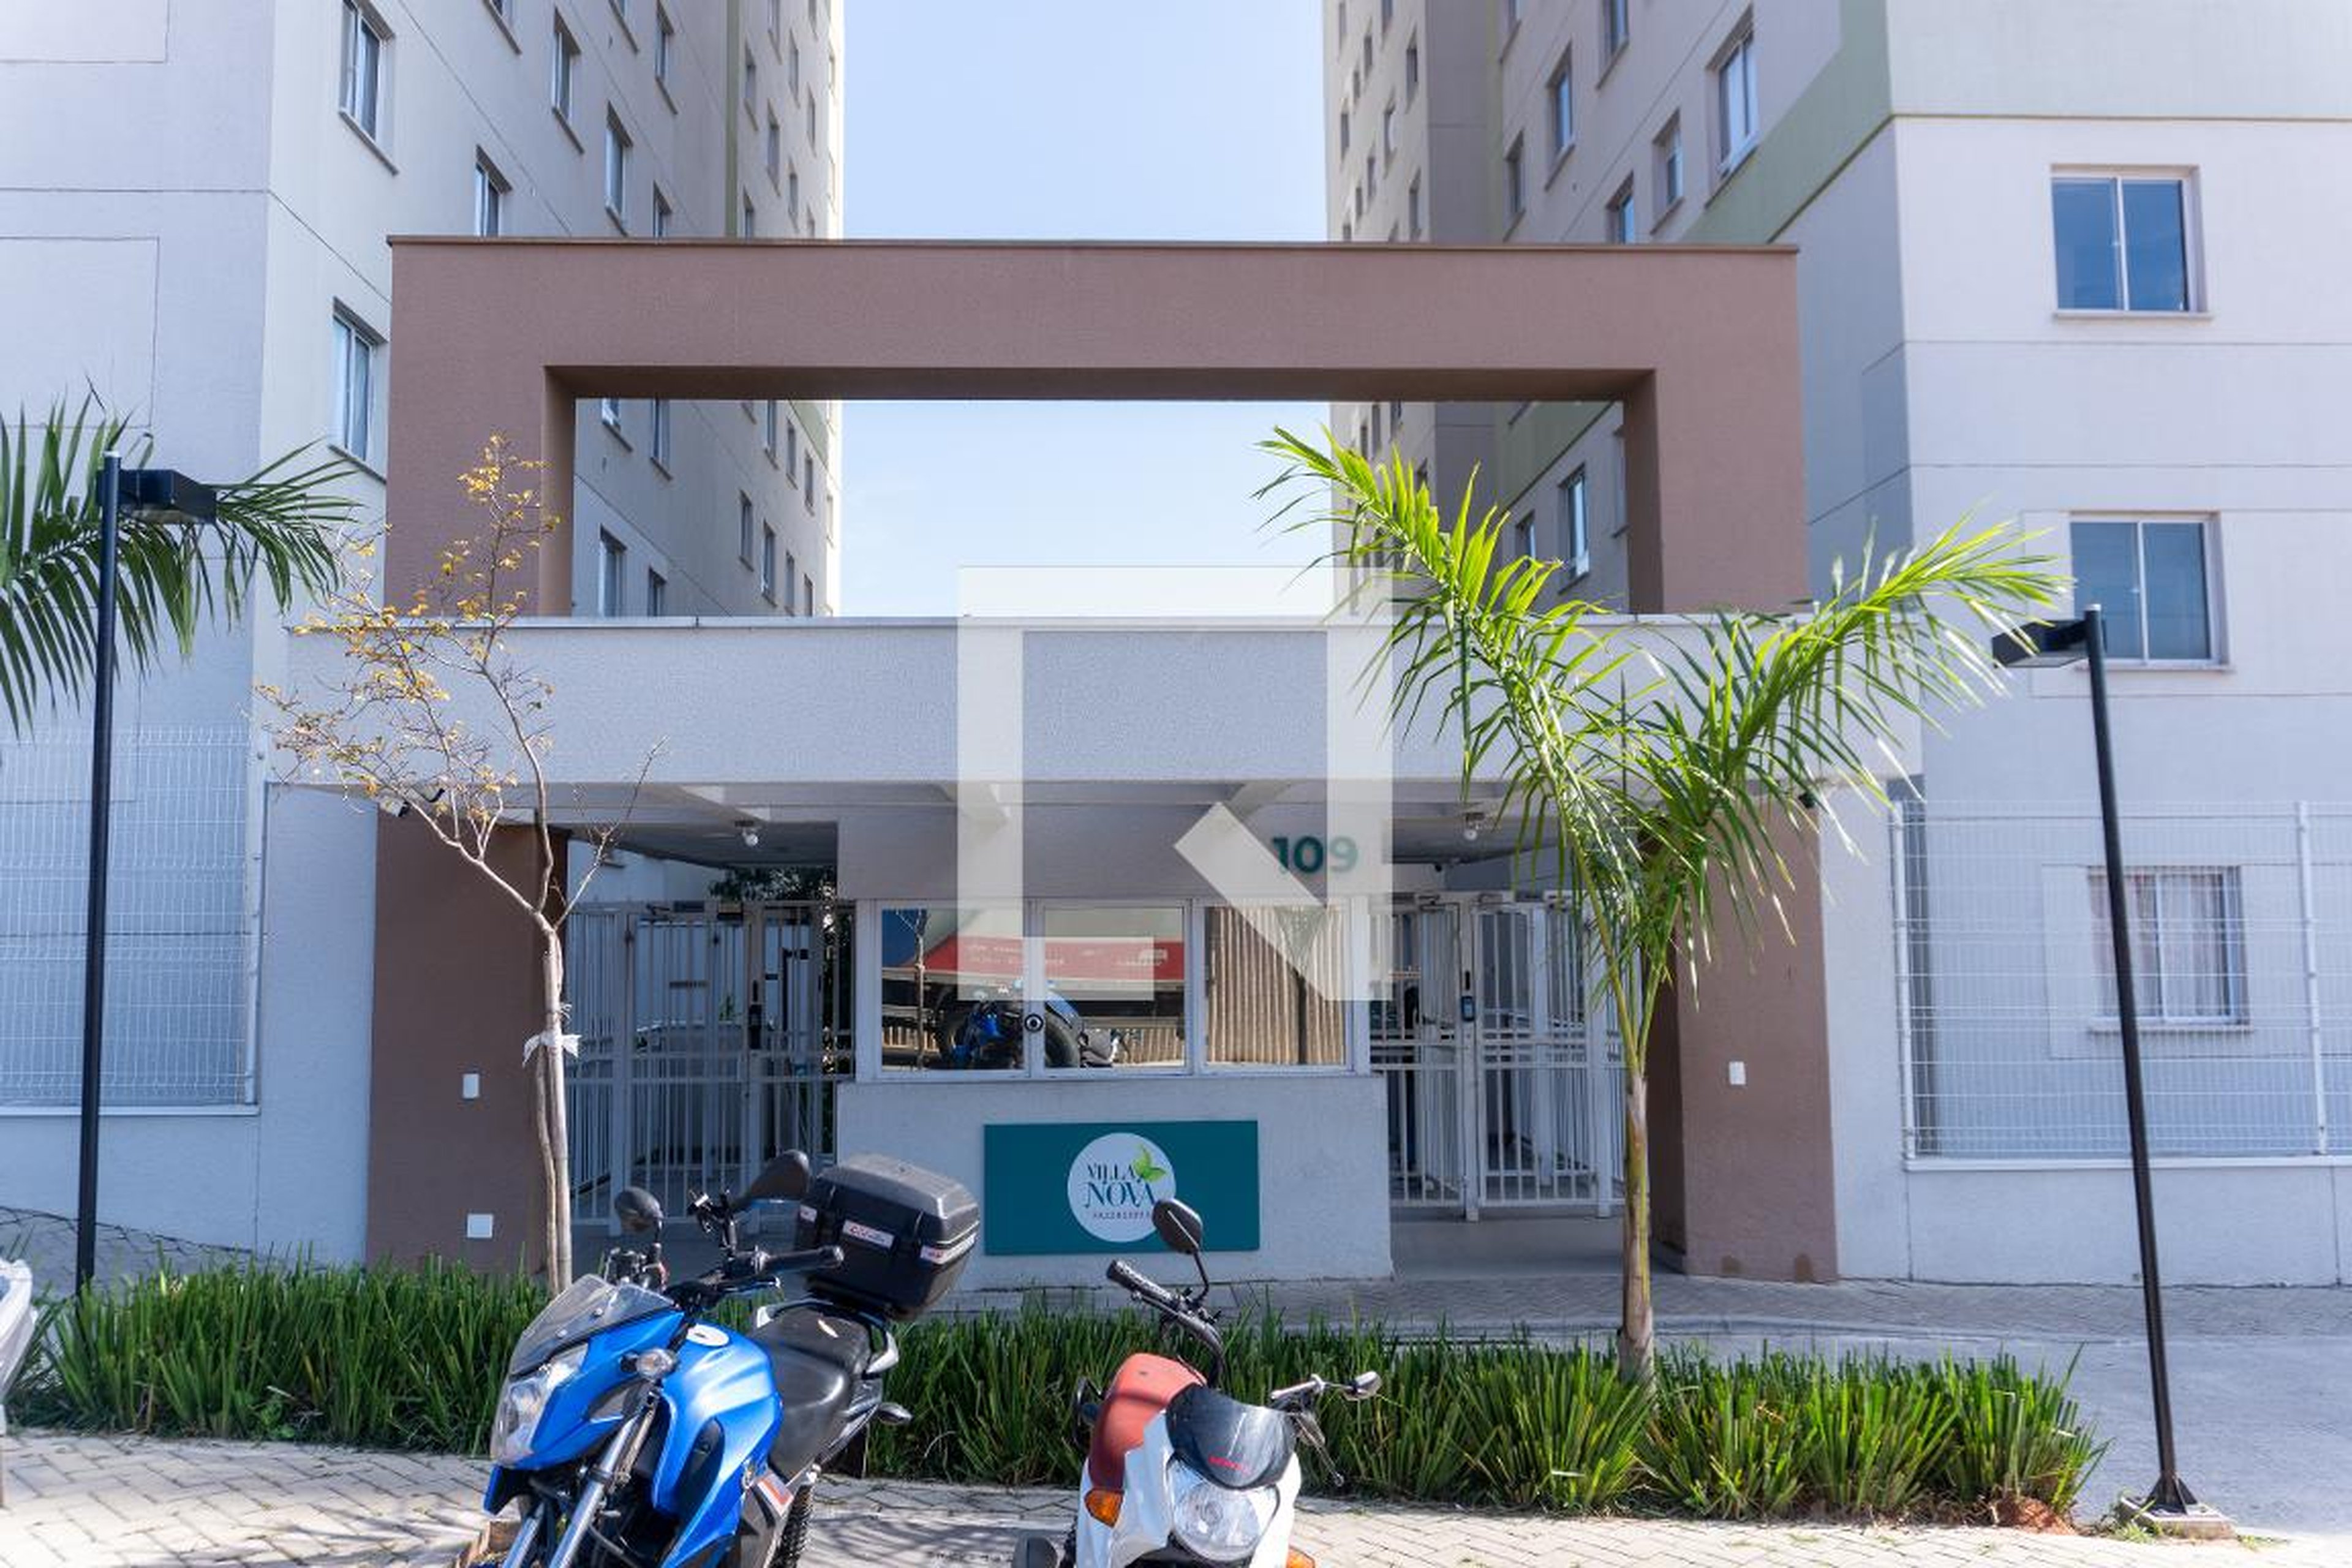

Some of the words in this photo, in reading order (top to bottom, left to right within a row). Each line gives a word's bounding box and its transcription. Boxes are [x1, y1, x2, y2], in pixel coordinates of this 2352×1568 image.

[1272, 835, 1359, 873] 109
[1087, 1163, 1136, 1183] VILLA
[1083, 1181, 1156, 1208] NOVA
